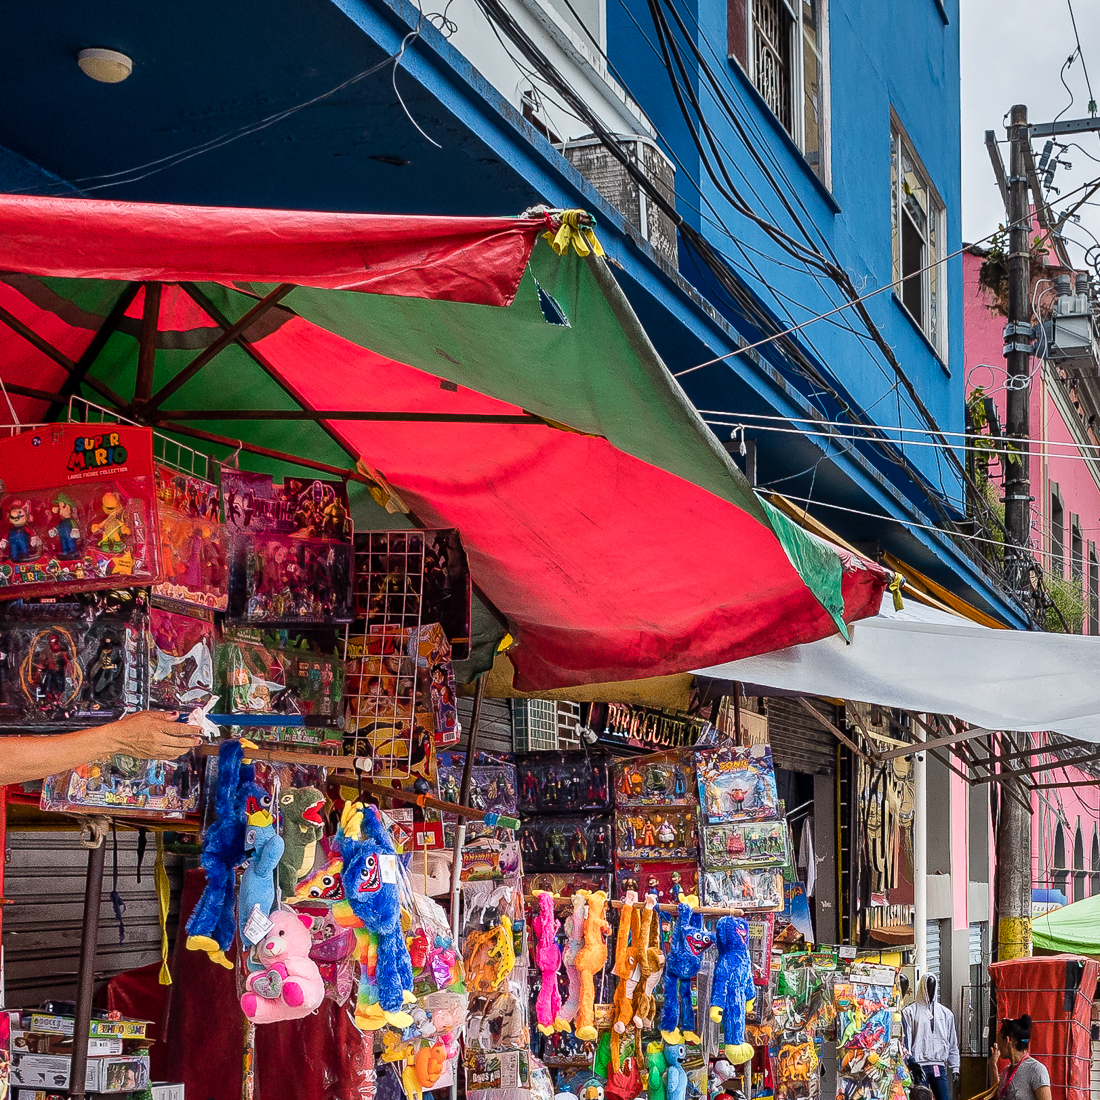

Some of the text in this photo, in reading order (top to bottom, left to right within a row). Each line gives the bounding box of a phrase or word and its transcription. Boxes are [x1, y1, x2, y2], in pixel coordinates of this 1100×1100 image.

[74, 432, 120, 451] SUPER
[67, 446, 128, 471] MARIO
[99, 466, 128, 476] COLLECTION
[15, 564, 41, 574] SUPER
[12, 571, 45, 584] MARIO
